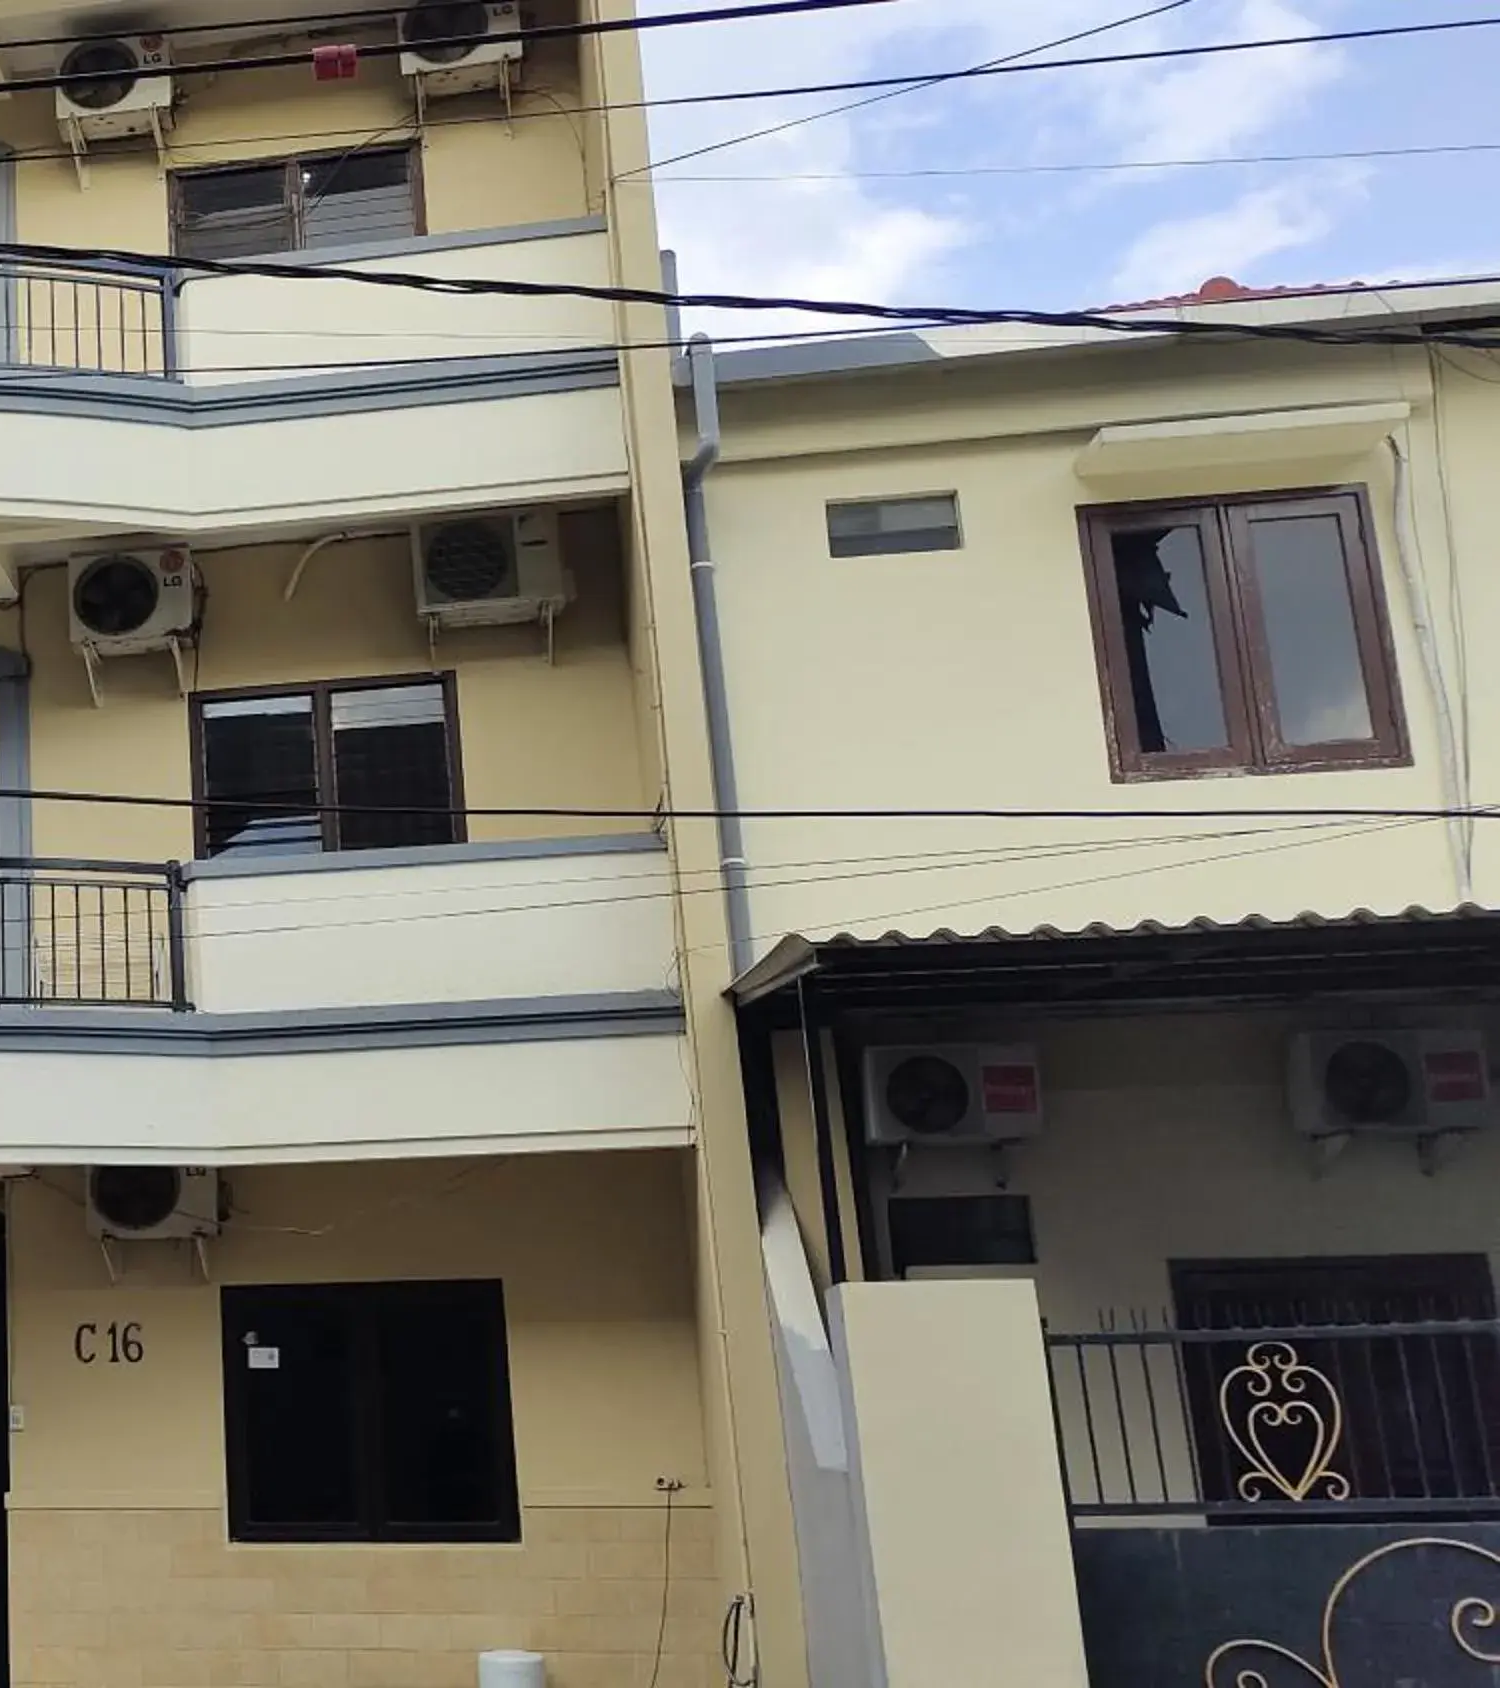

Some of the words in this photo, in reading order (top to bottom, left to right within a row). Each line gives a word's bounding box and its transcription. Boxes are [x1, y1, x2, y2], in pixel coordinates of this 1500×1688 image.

[493, 4, 513, 17] LG
[143, 53, 161, 65] LG
[163, 575, 181, 587] LG
[75, 1323, 96, 1364] C
[107, 1321, 143, 1363] 16
